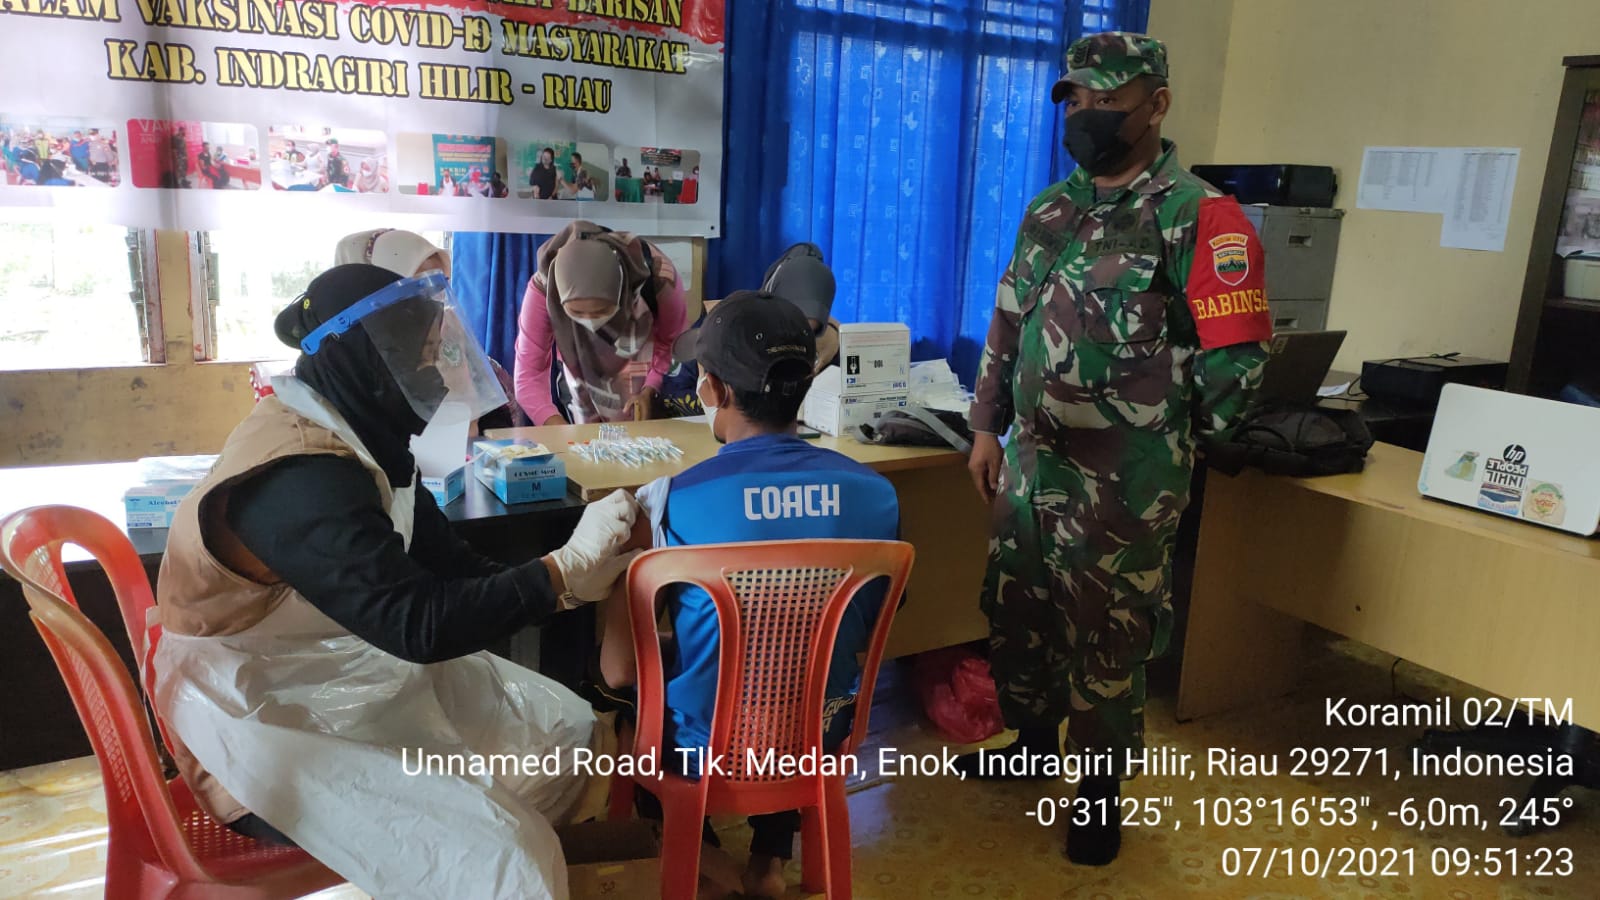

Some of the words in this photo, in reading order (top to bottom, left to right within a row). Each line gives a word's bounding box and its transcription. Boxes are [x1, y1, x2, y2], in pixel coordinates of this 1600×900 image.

[138, 0, 339, 40] VAKSINASI
[350, 5, 491, 51] COVID-19
[502, 19, 690, 74] MASYARAKAT
[105, 38, 206, 83] KAB.
[215, 48, 409, 97] INDRAGIRI
[418, 62, 514, 105] HILIR
[542, 74, 612, 113] RIAU
[1192, 288, 1270, 320] BABINSA
[1487, 459, 1528, 475] PEOPLE
[1504, 444, 1526, 465] hp
[531, 481, 541, 492] M
[1486, 470, 1525, 488] INHIL
[743, 483, 841, 521] COACH
